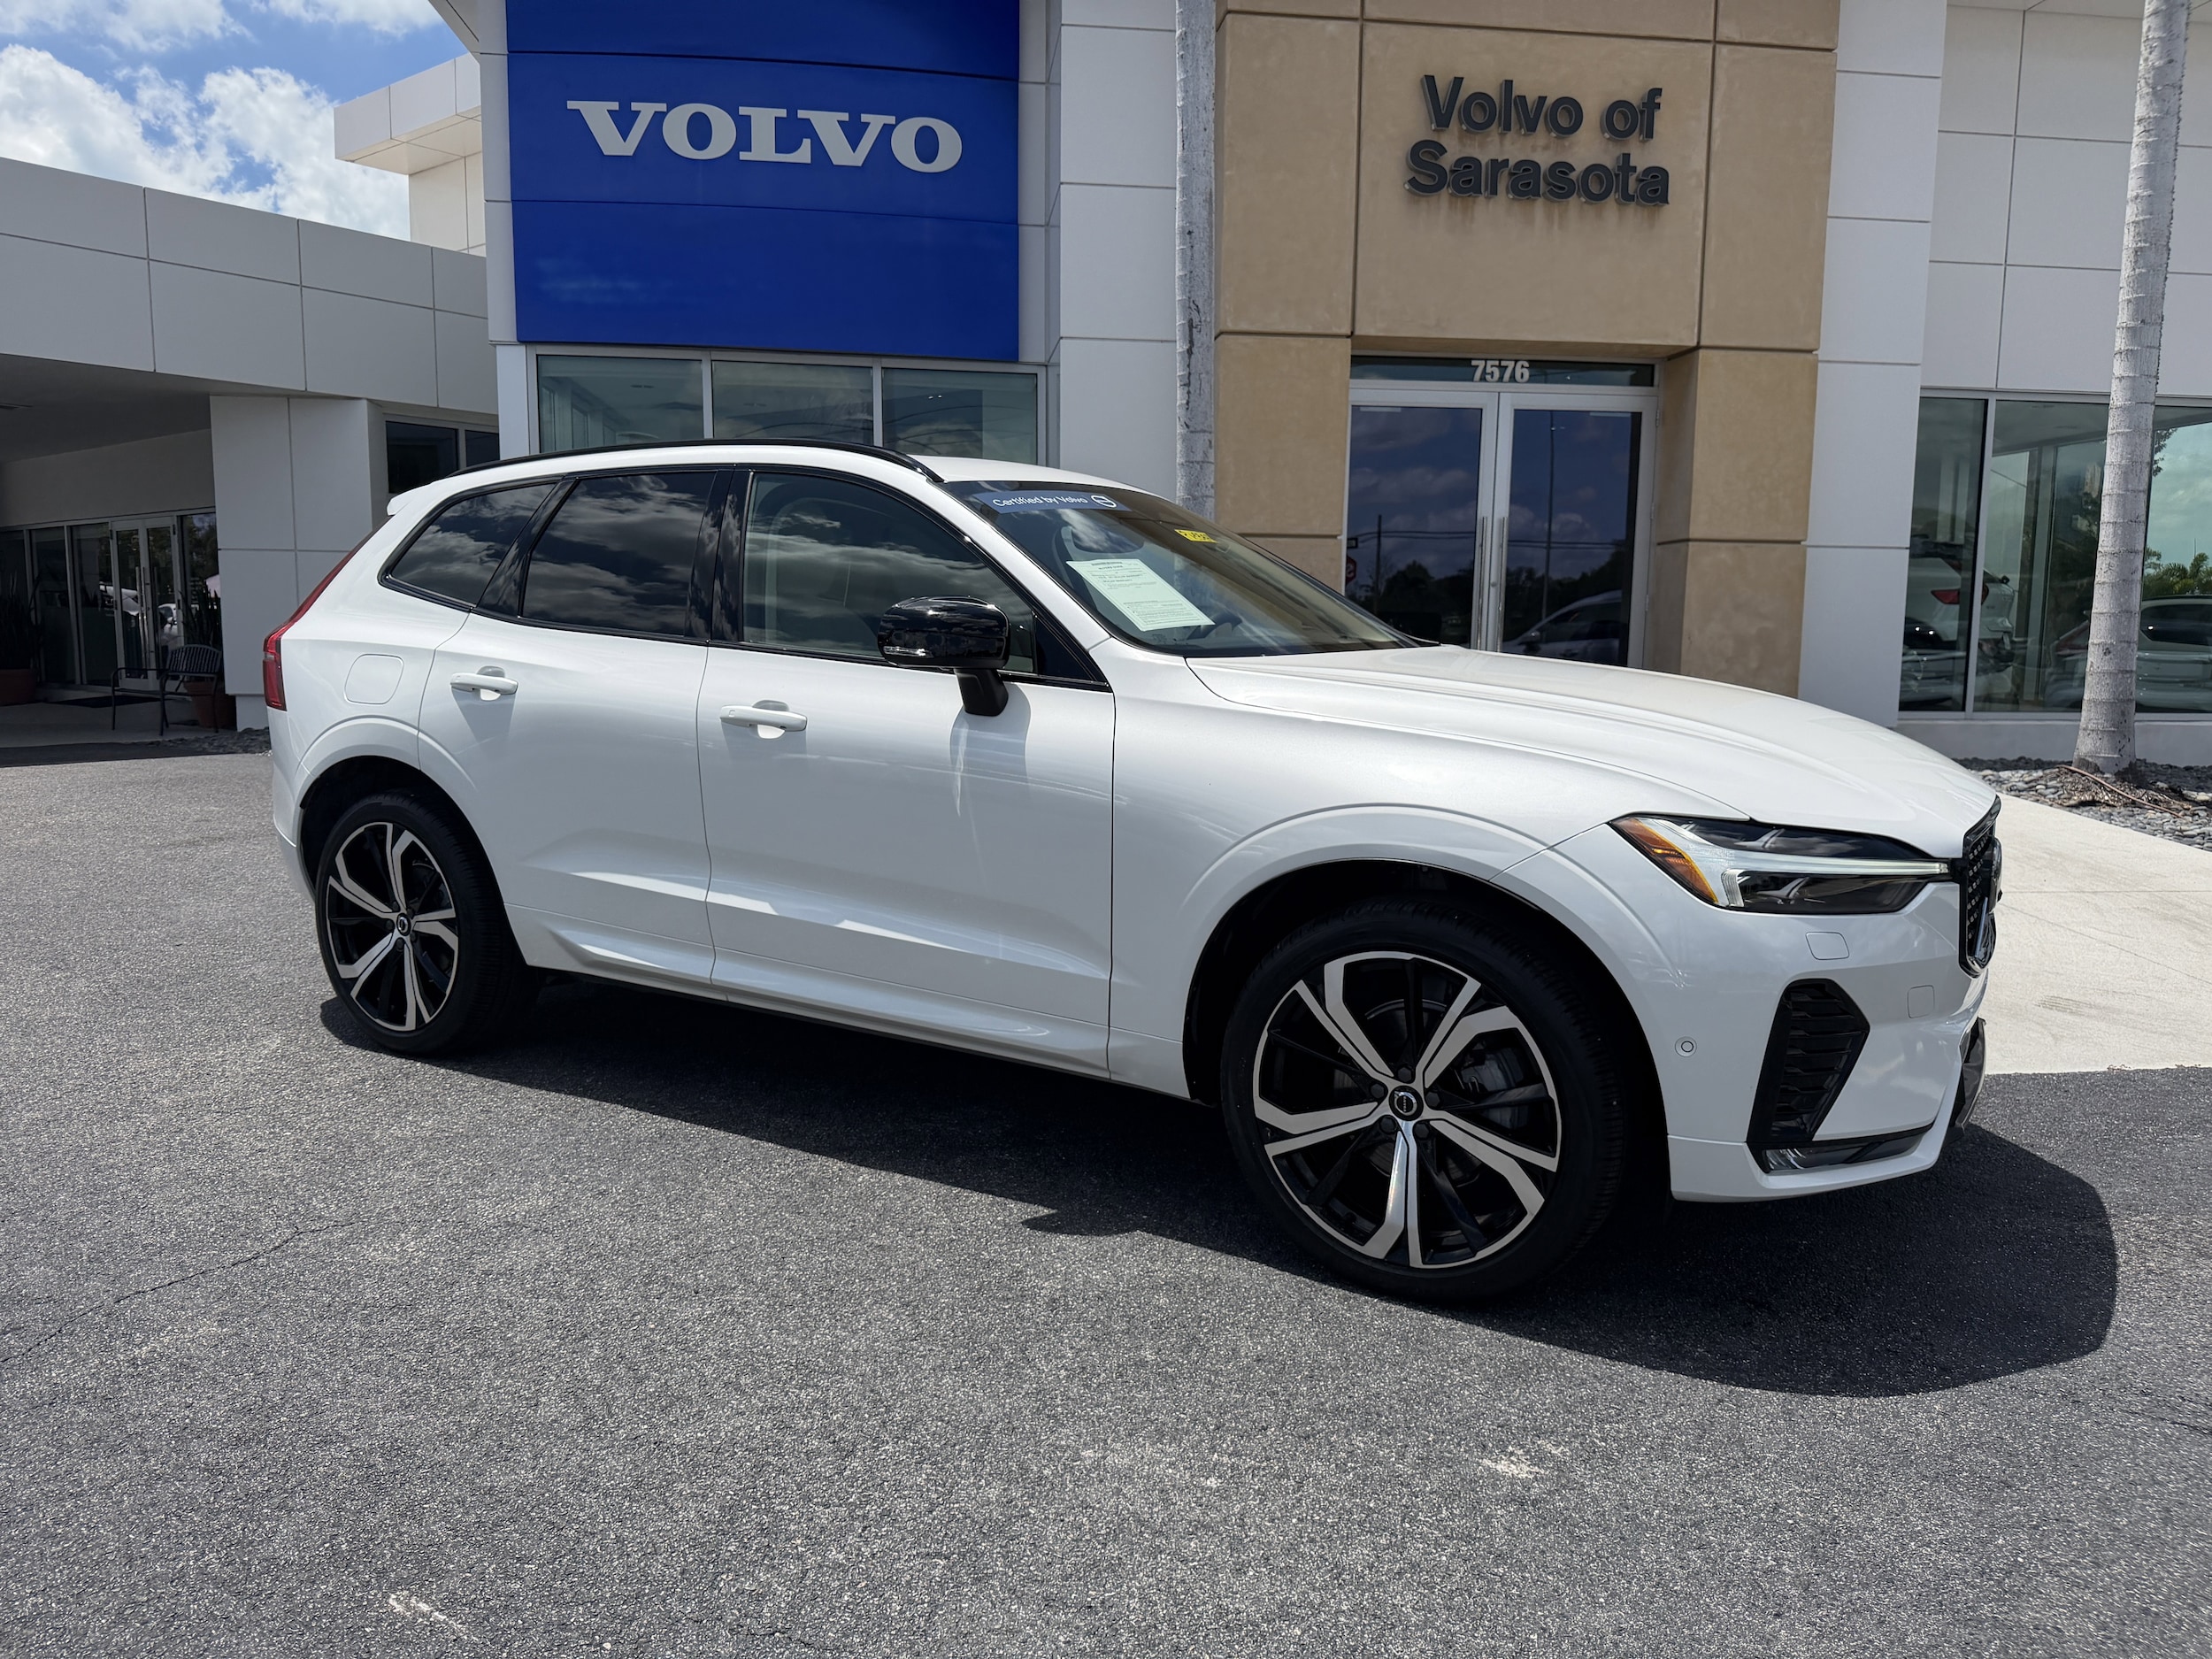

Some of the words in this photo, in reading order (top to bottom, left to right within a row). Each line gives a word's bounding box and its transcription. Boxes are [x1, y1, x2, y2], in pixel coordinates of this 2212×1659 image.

[566, 100, 963, 173] VOLVO
[1421, 74, 1584, 138] Volvo
[1601, 88, 1663, 141] of
[1404, 139, 1670, 206] Sarasota
[1471, 359, 1530, 383] 7576
[992, 495, 1043, 507] Certified
[1041, 495, 1059, 504] by
